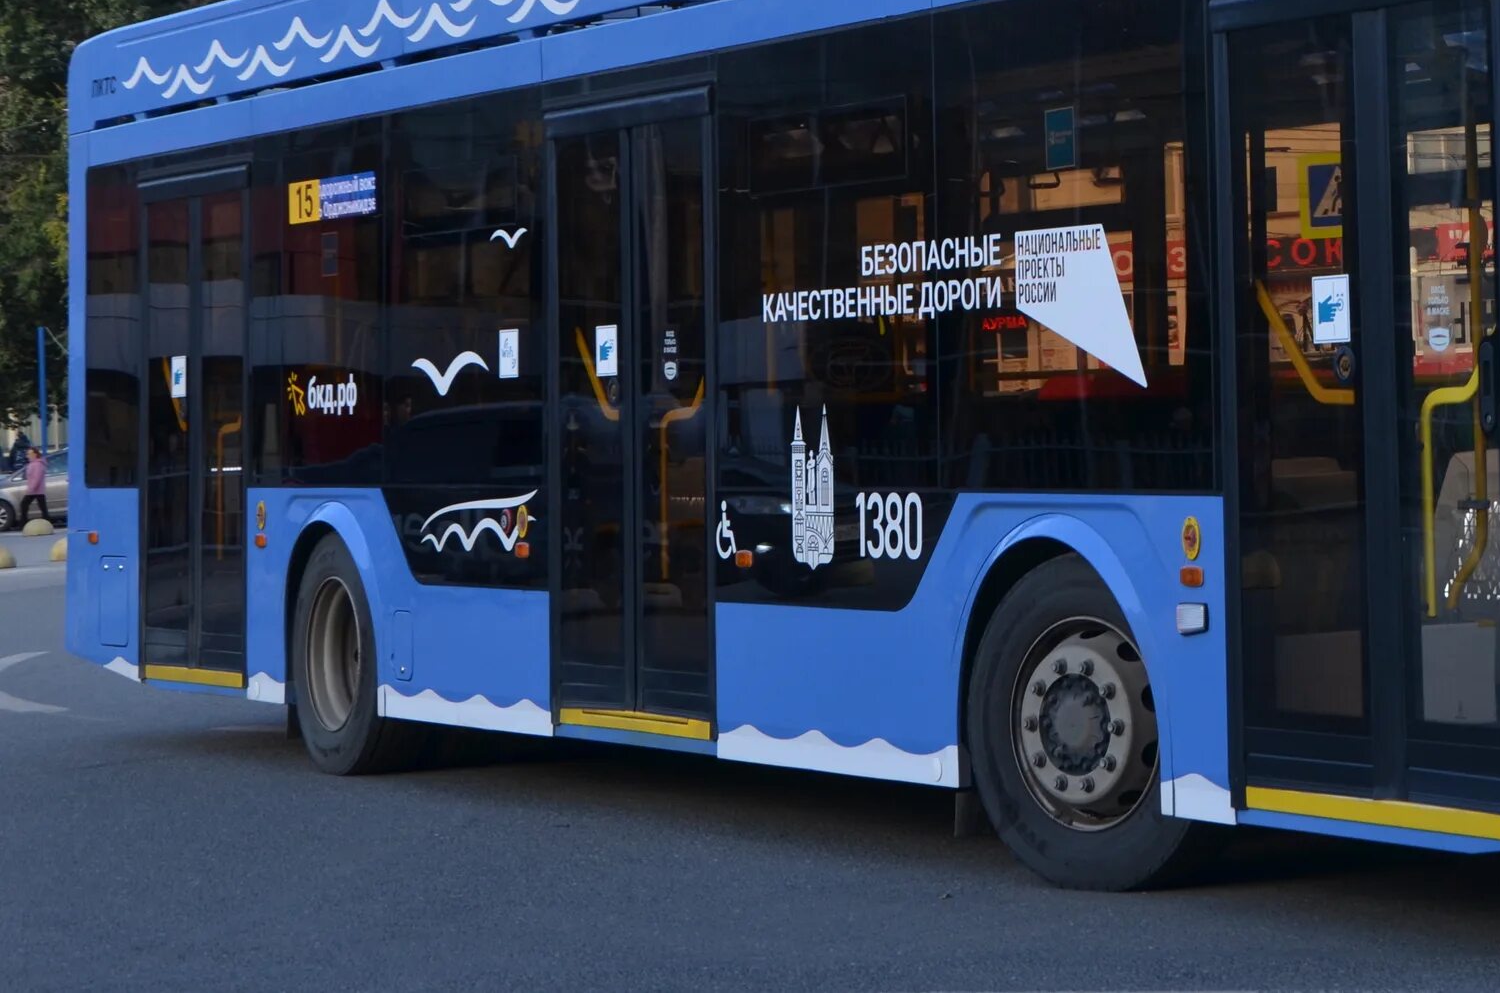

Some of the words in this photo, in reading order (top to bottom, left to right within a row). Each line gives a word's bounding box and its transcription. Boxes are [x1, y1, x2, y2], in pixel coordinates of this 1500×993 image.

[296, 184, 313, 219] 15
[861, 233, 1001, 276] БЕЗОПАСНЫЕ
[1018, 228, 1101, 257] НАЦИОНАЛЬНЫЕ
[1018, 256, 1065, 280] ПРОЕКТЫ
[763, 283, 914, 323] КАЧЕСТВЕННЫЕ
[919, 276, 1001, 319] ДОРОГИ
[1018, 281, 1057, 304] РОССИИ
[308, 373, 357, 415] бкд.рф
[856, 492, 922, 560] 1380
